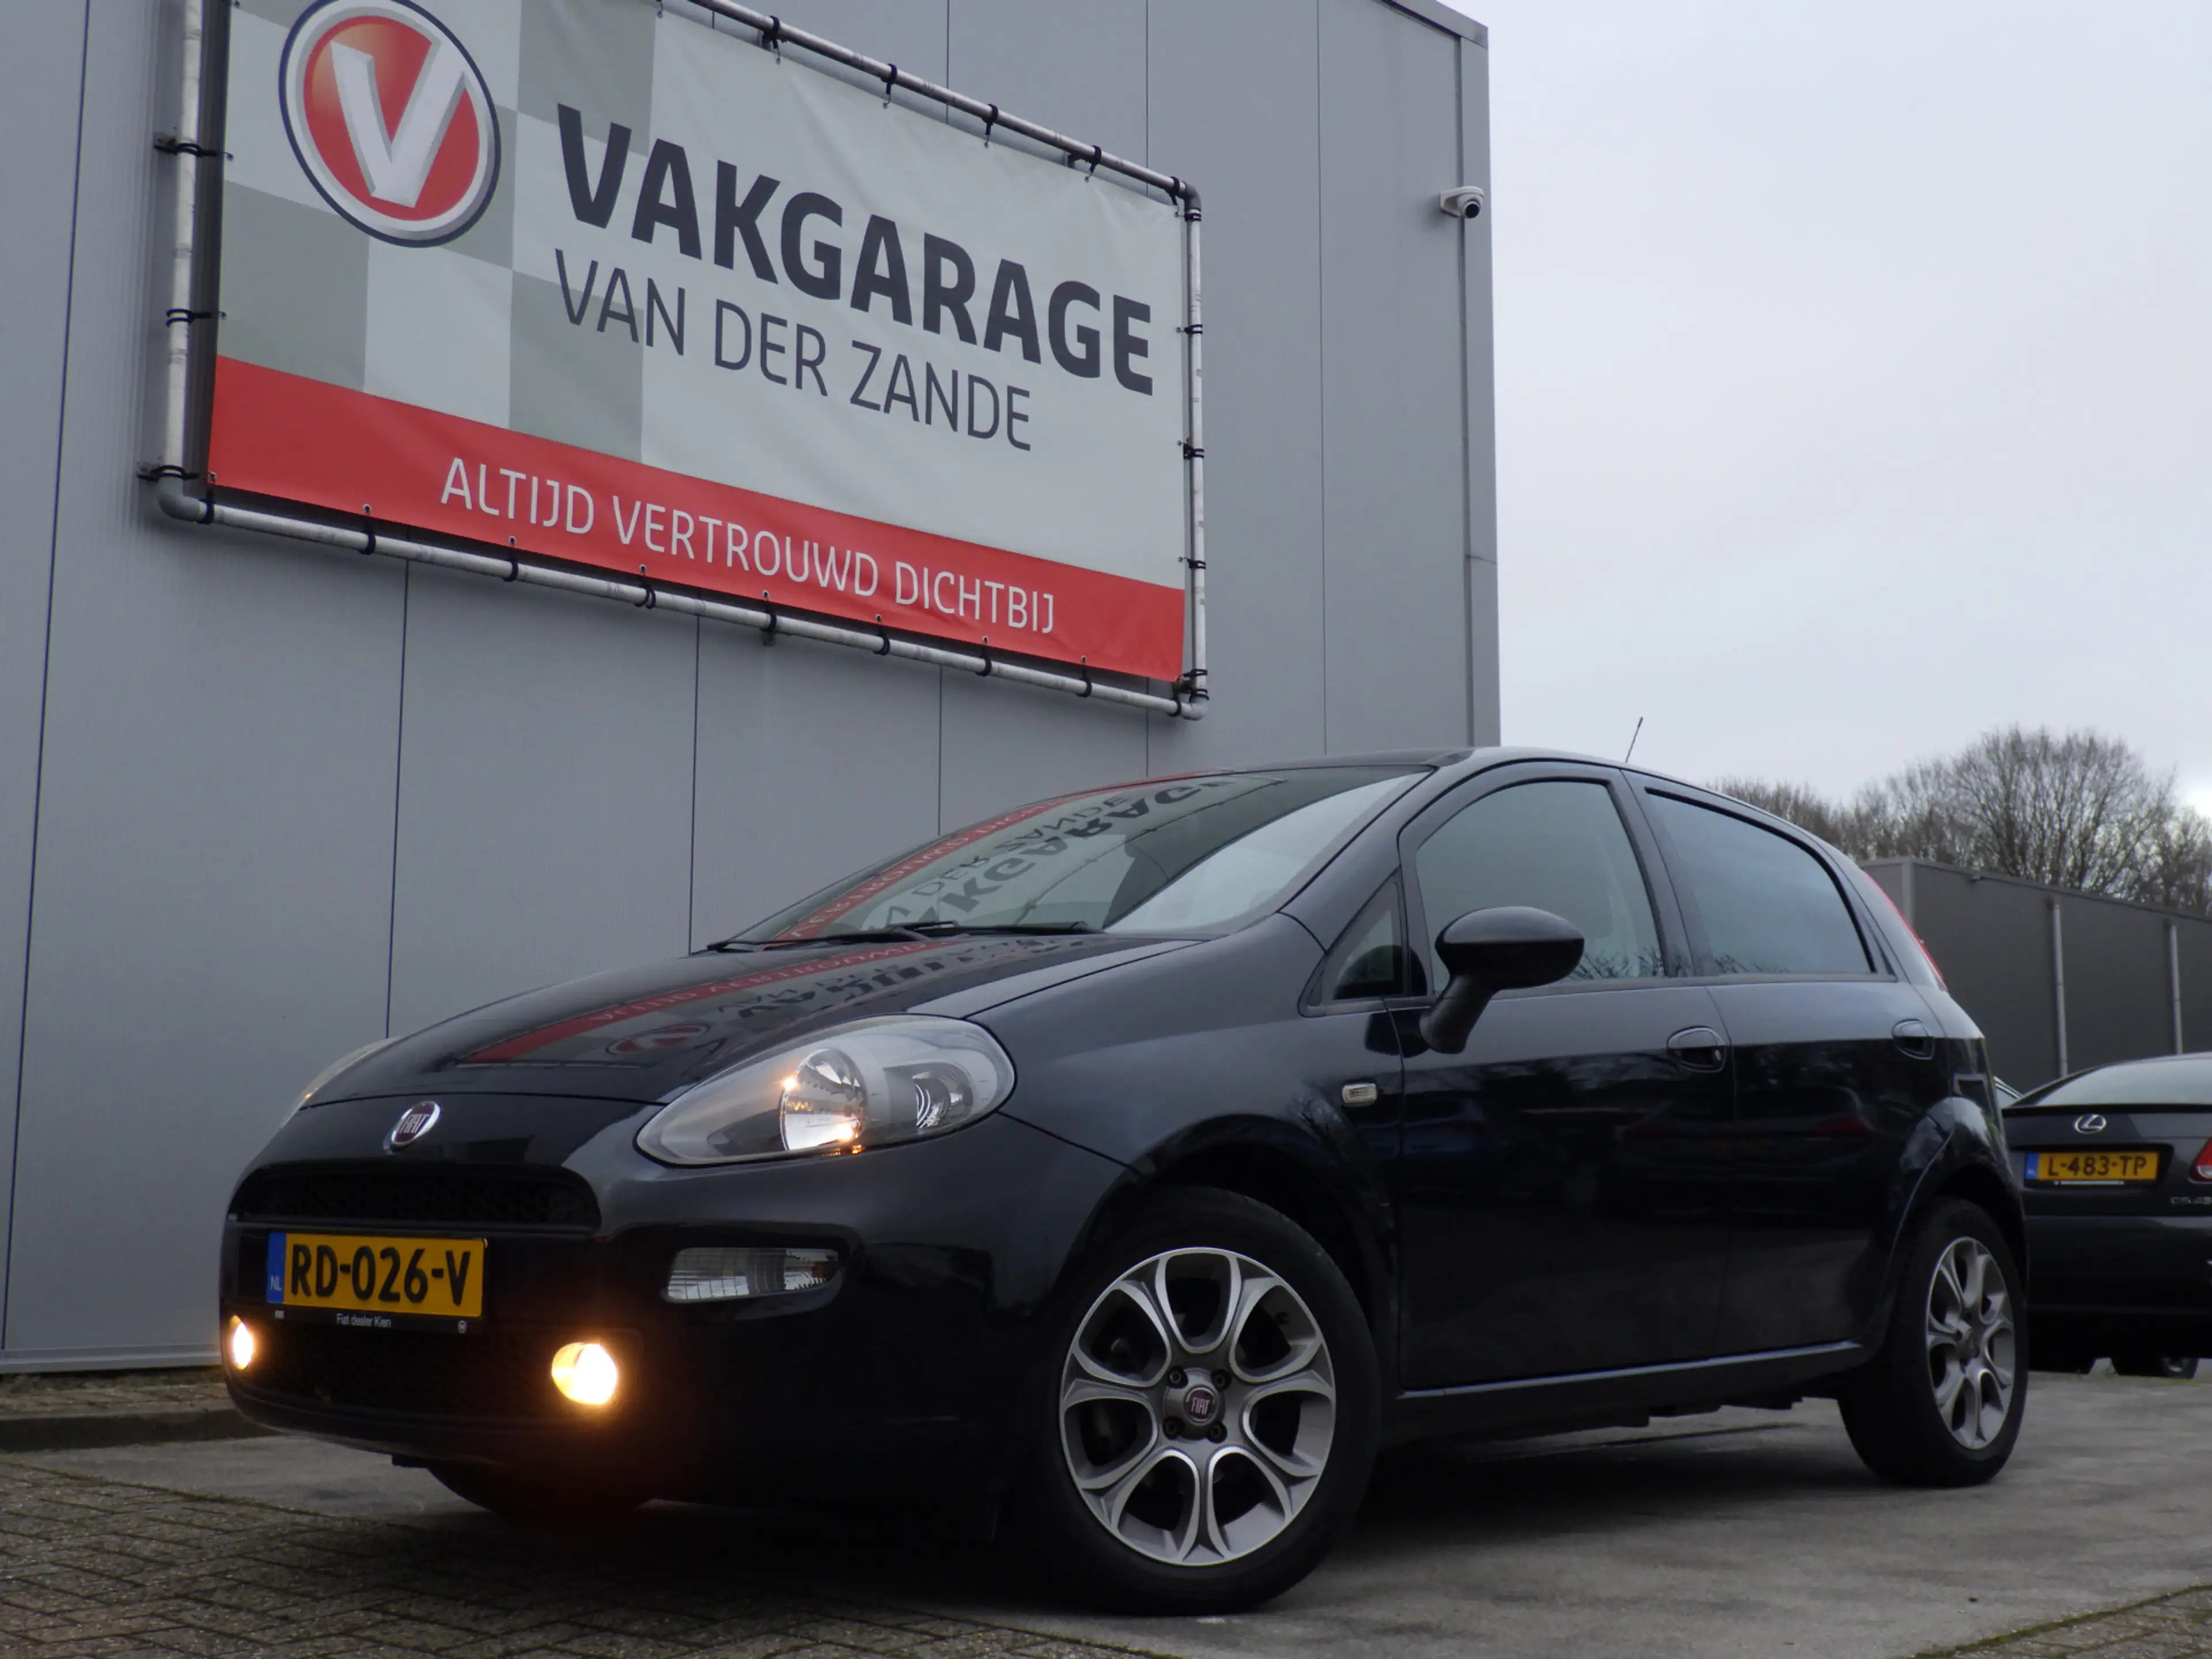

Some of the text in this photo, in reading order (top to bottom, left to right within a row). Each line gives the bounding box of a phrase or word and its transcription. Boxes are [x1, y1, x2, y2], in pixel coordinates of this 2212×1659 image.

[557, 103, 1154, 396] VAKGARAGE
[554, 247, 1031, 452] VAN DER ZANDE
[440, 457, 1054, 634] ALTIJD VERTROUWD DICHTBIJ
[2047, 1156, 2147, 1177] L-483-TP
[270, 1274, 282, 1291] NL
[290, 1243, 472, 1306] RD-026-V
[1191, 1397, 1210, 1415] FIAT
